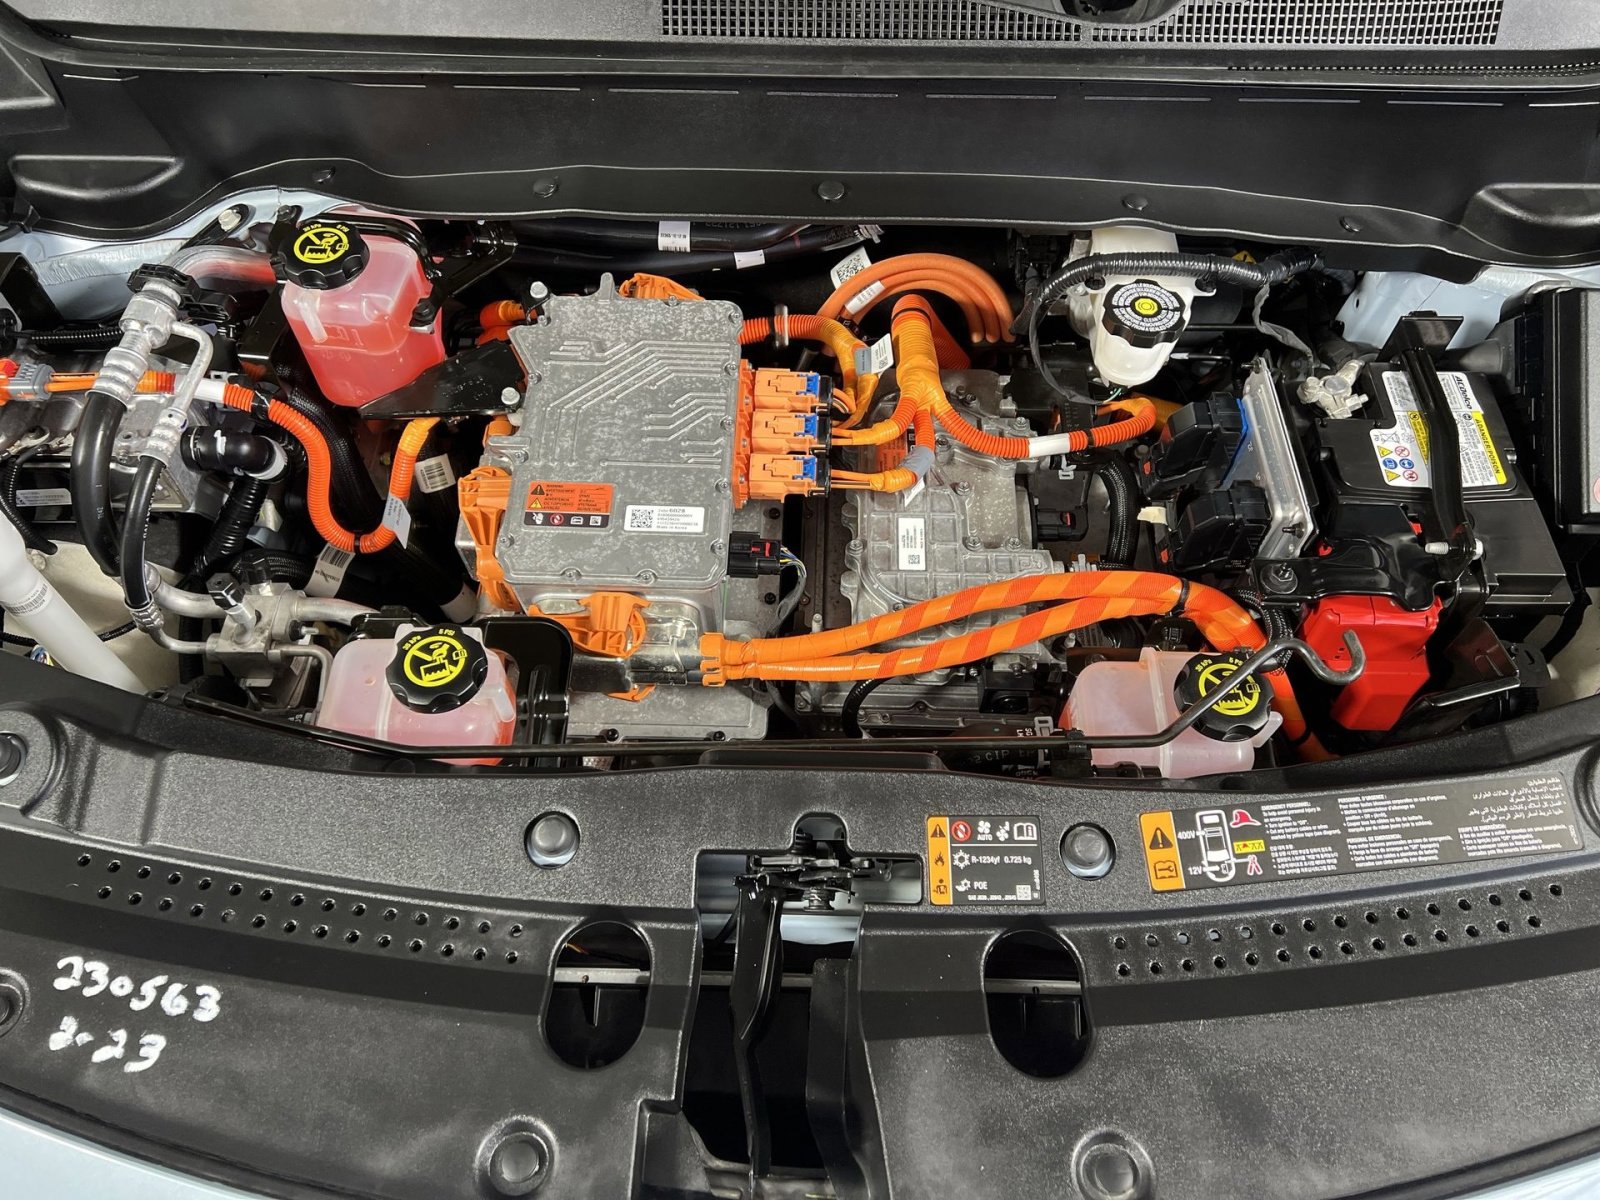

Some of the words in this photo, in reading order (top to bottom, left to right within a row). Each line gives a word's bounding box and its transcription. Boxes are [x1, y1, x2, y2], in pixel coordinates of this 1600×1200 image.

[1454, 375, 1472, 410] ACDelco
[1177, 830, 1196, 840] 400V
[971, 856, 1000, 864] R-1234yf
[1023, 856, 1032, 865] kg
[1188, 866, 1202, 875] 12V
[973, 882, 988, 890] POE
[53, 956, 222, 1022] 230563
